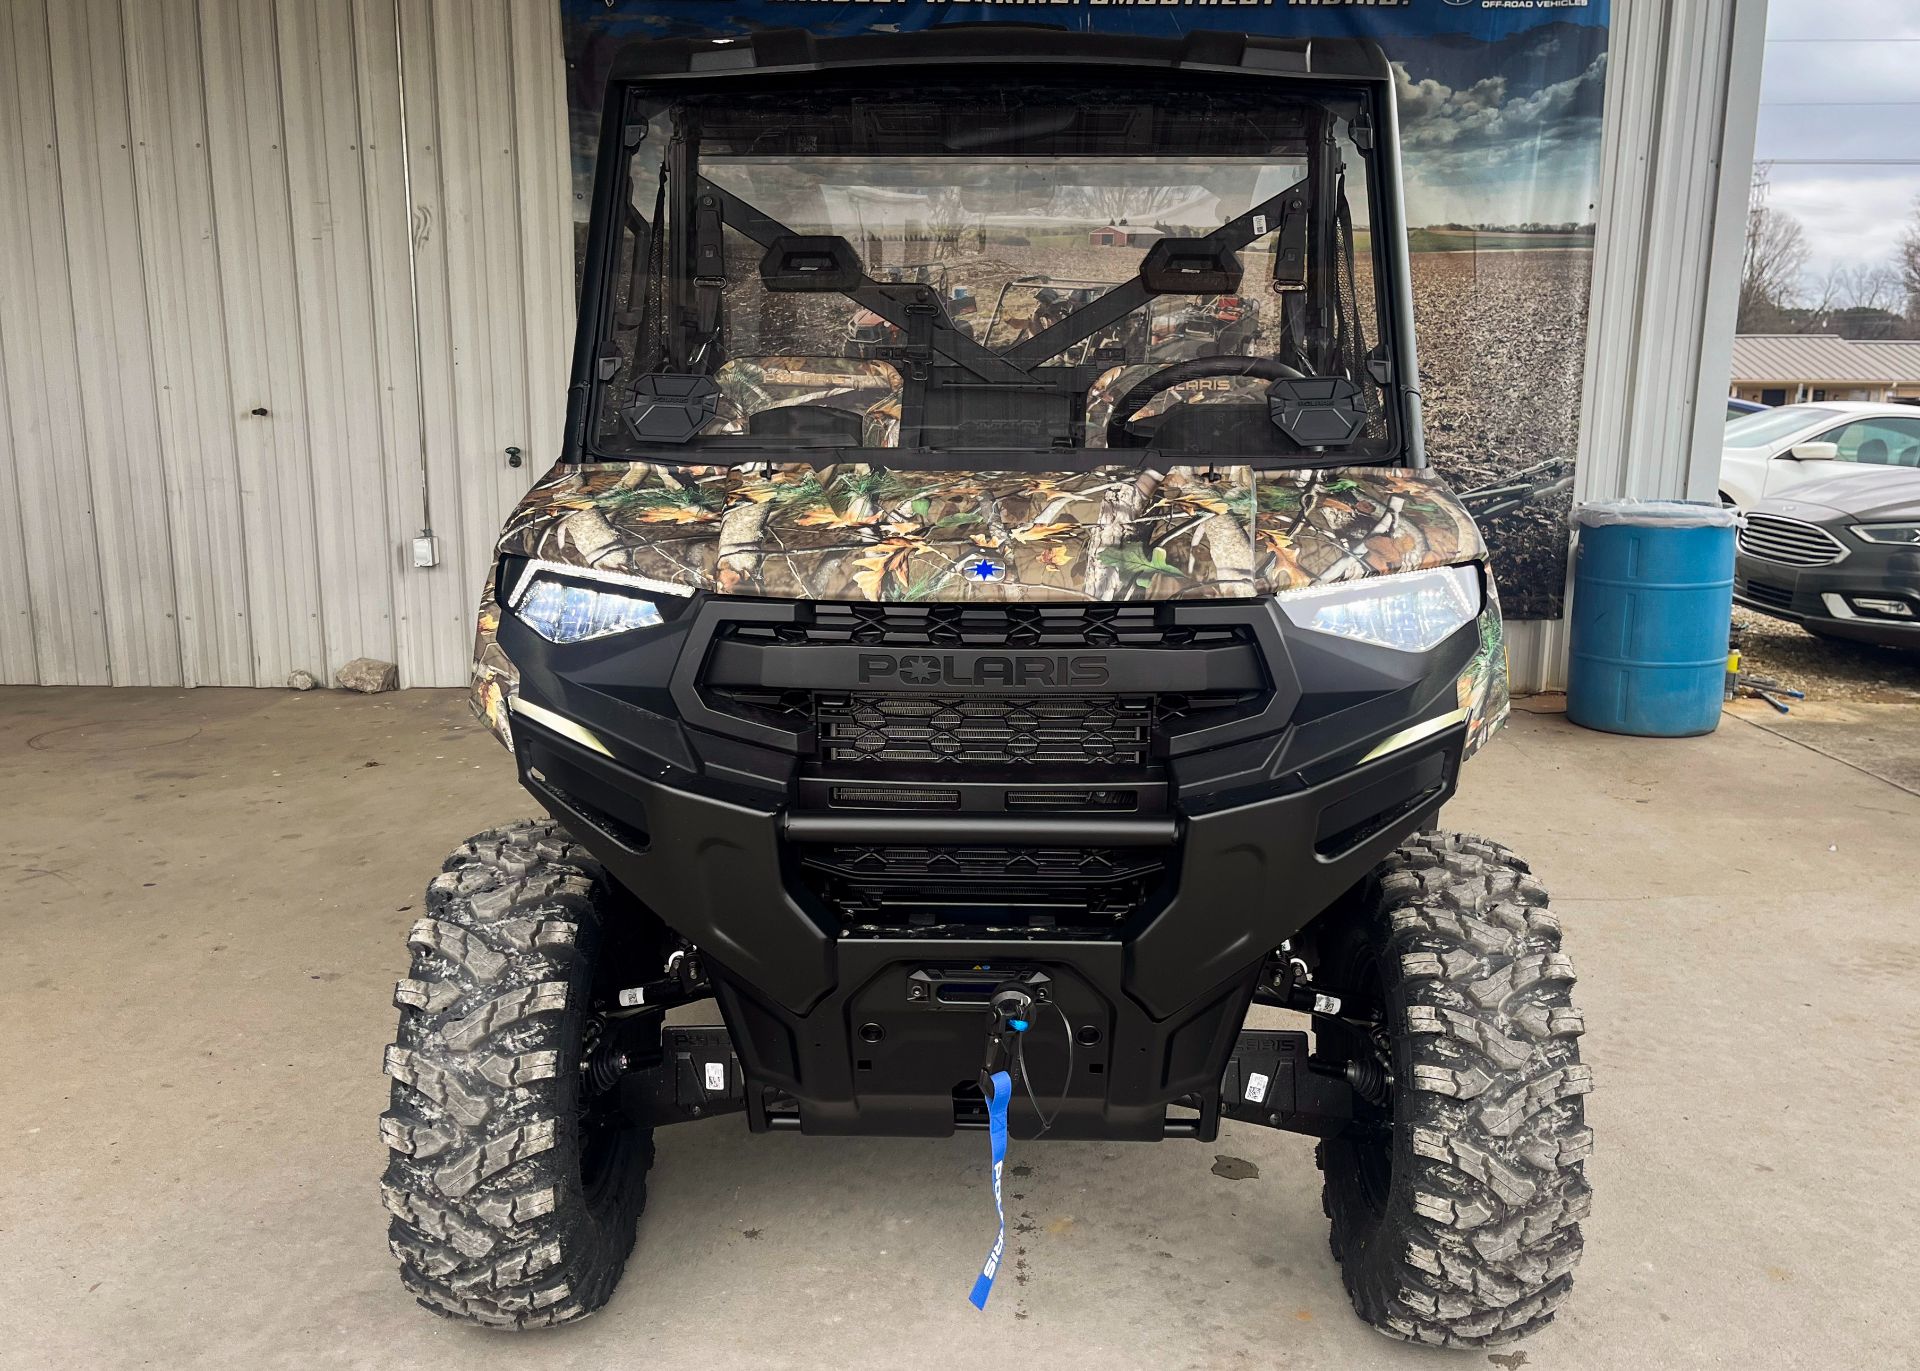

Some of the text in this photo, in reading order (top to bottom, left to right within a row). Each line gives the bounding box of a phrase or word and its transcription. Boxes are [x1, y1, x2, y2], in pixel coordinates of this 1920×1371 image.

[1168, 379, 1231, 391] LARIS
[858, 654, 1110, 687] POLARIS
[984, 1160, 1004, 1281] PORIS
